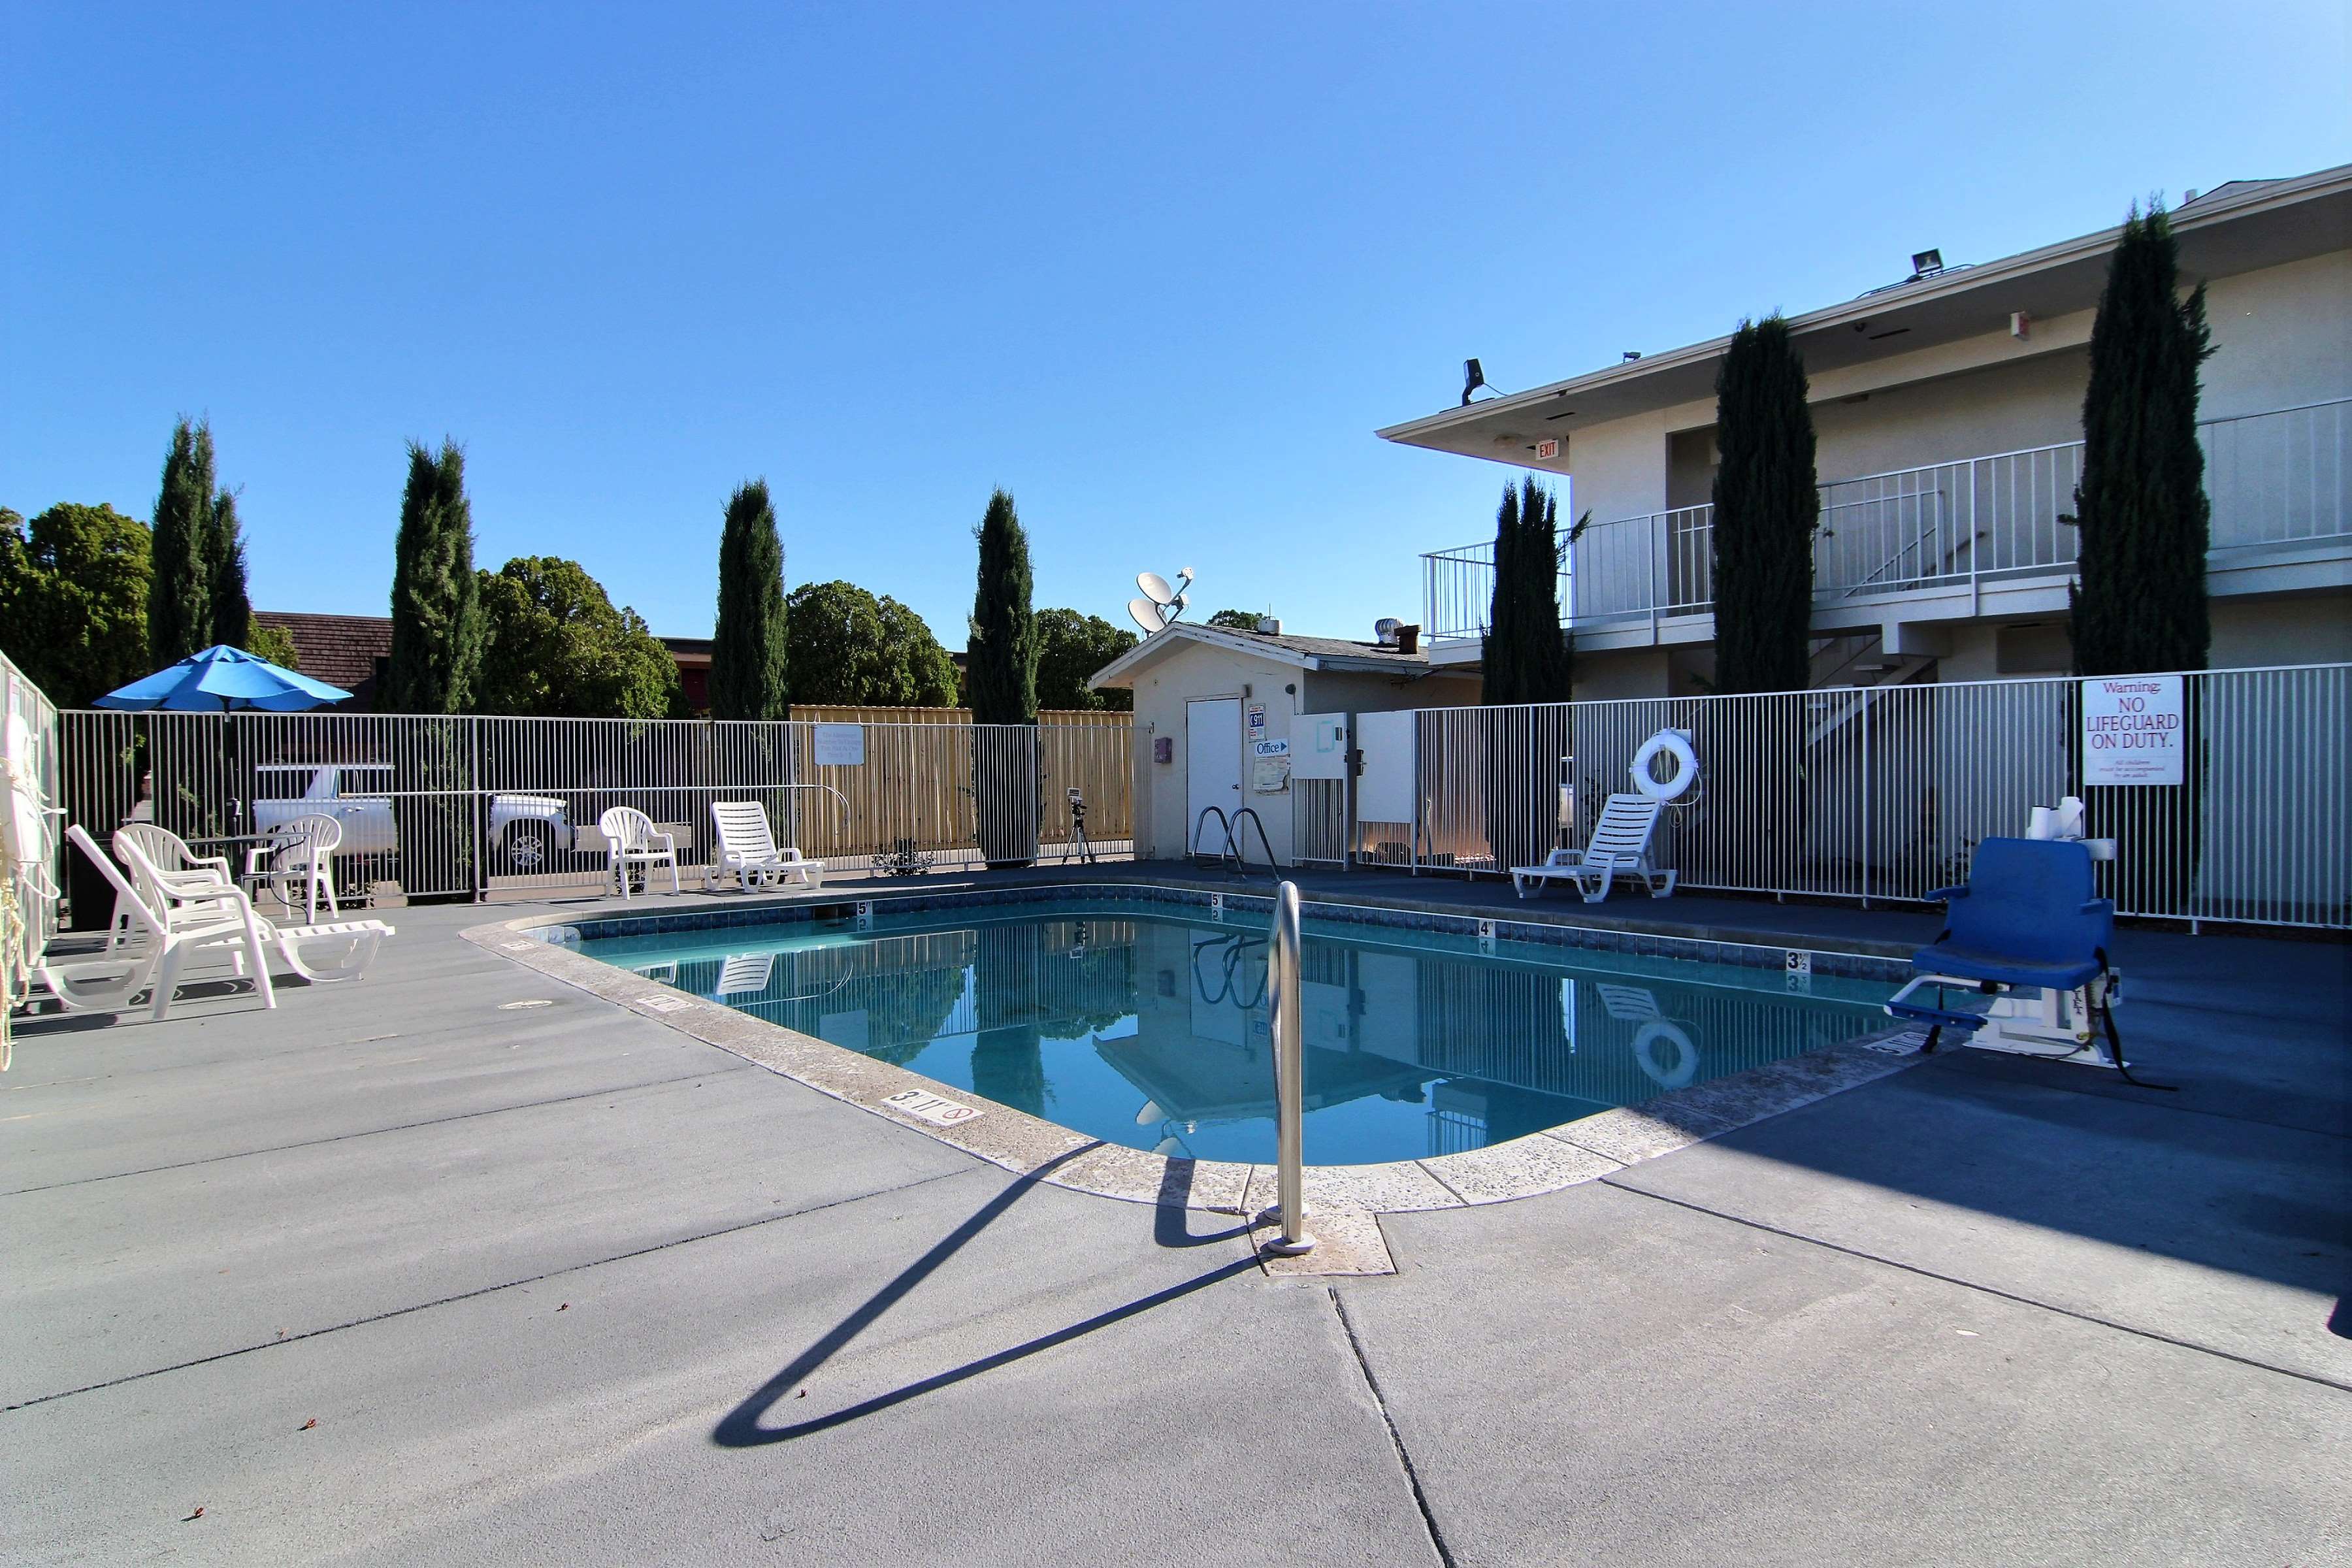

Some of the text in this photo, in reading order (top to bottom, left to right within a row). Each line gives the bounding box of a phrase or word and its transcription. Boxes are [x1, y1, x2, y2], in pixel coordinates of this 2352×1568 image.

[1540, 442, 1554, 457] EXIT
[2119, 697, 2145, 713] NO
[1254, 713, 1263, 726] 911
[2087, 714, 2179, 732] LIFEGUARD
[1257, 742, 1279, 754] Office
[2092, 732, 2174, 749] ON DUTY.
[1213, 894, 1218, 906] 5
[858, 902, 866, 914] 5
[1480, 921, 1488, 936] 4
